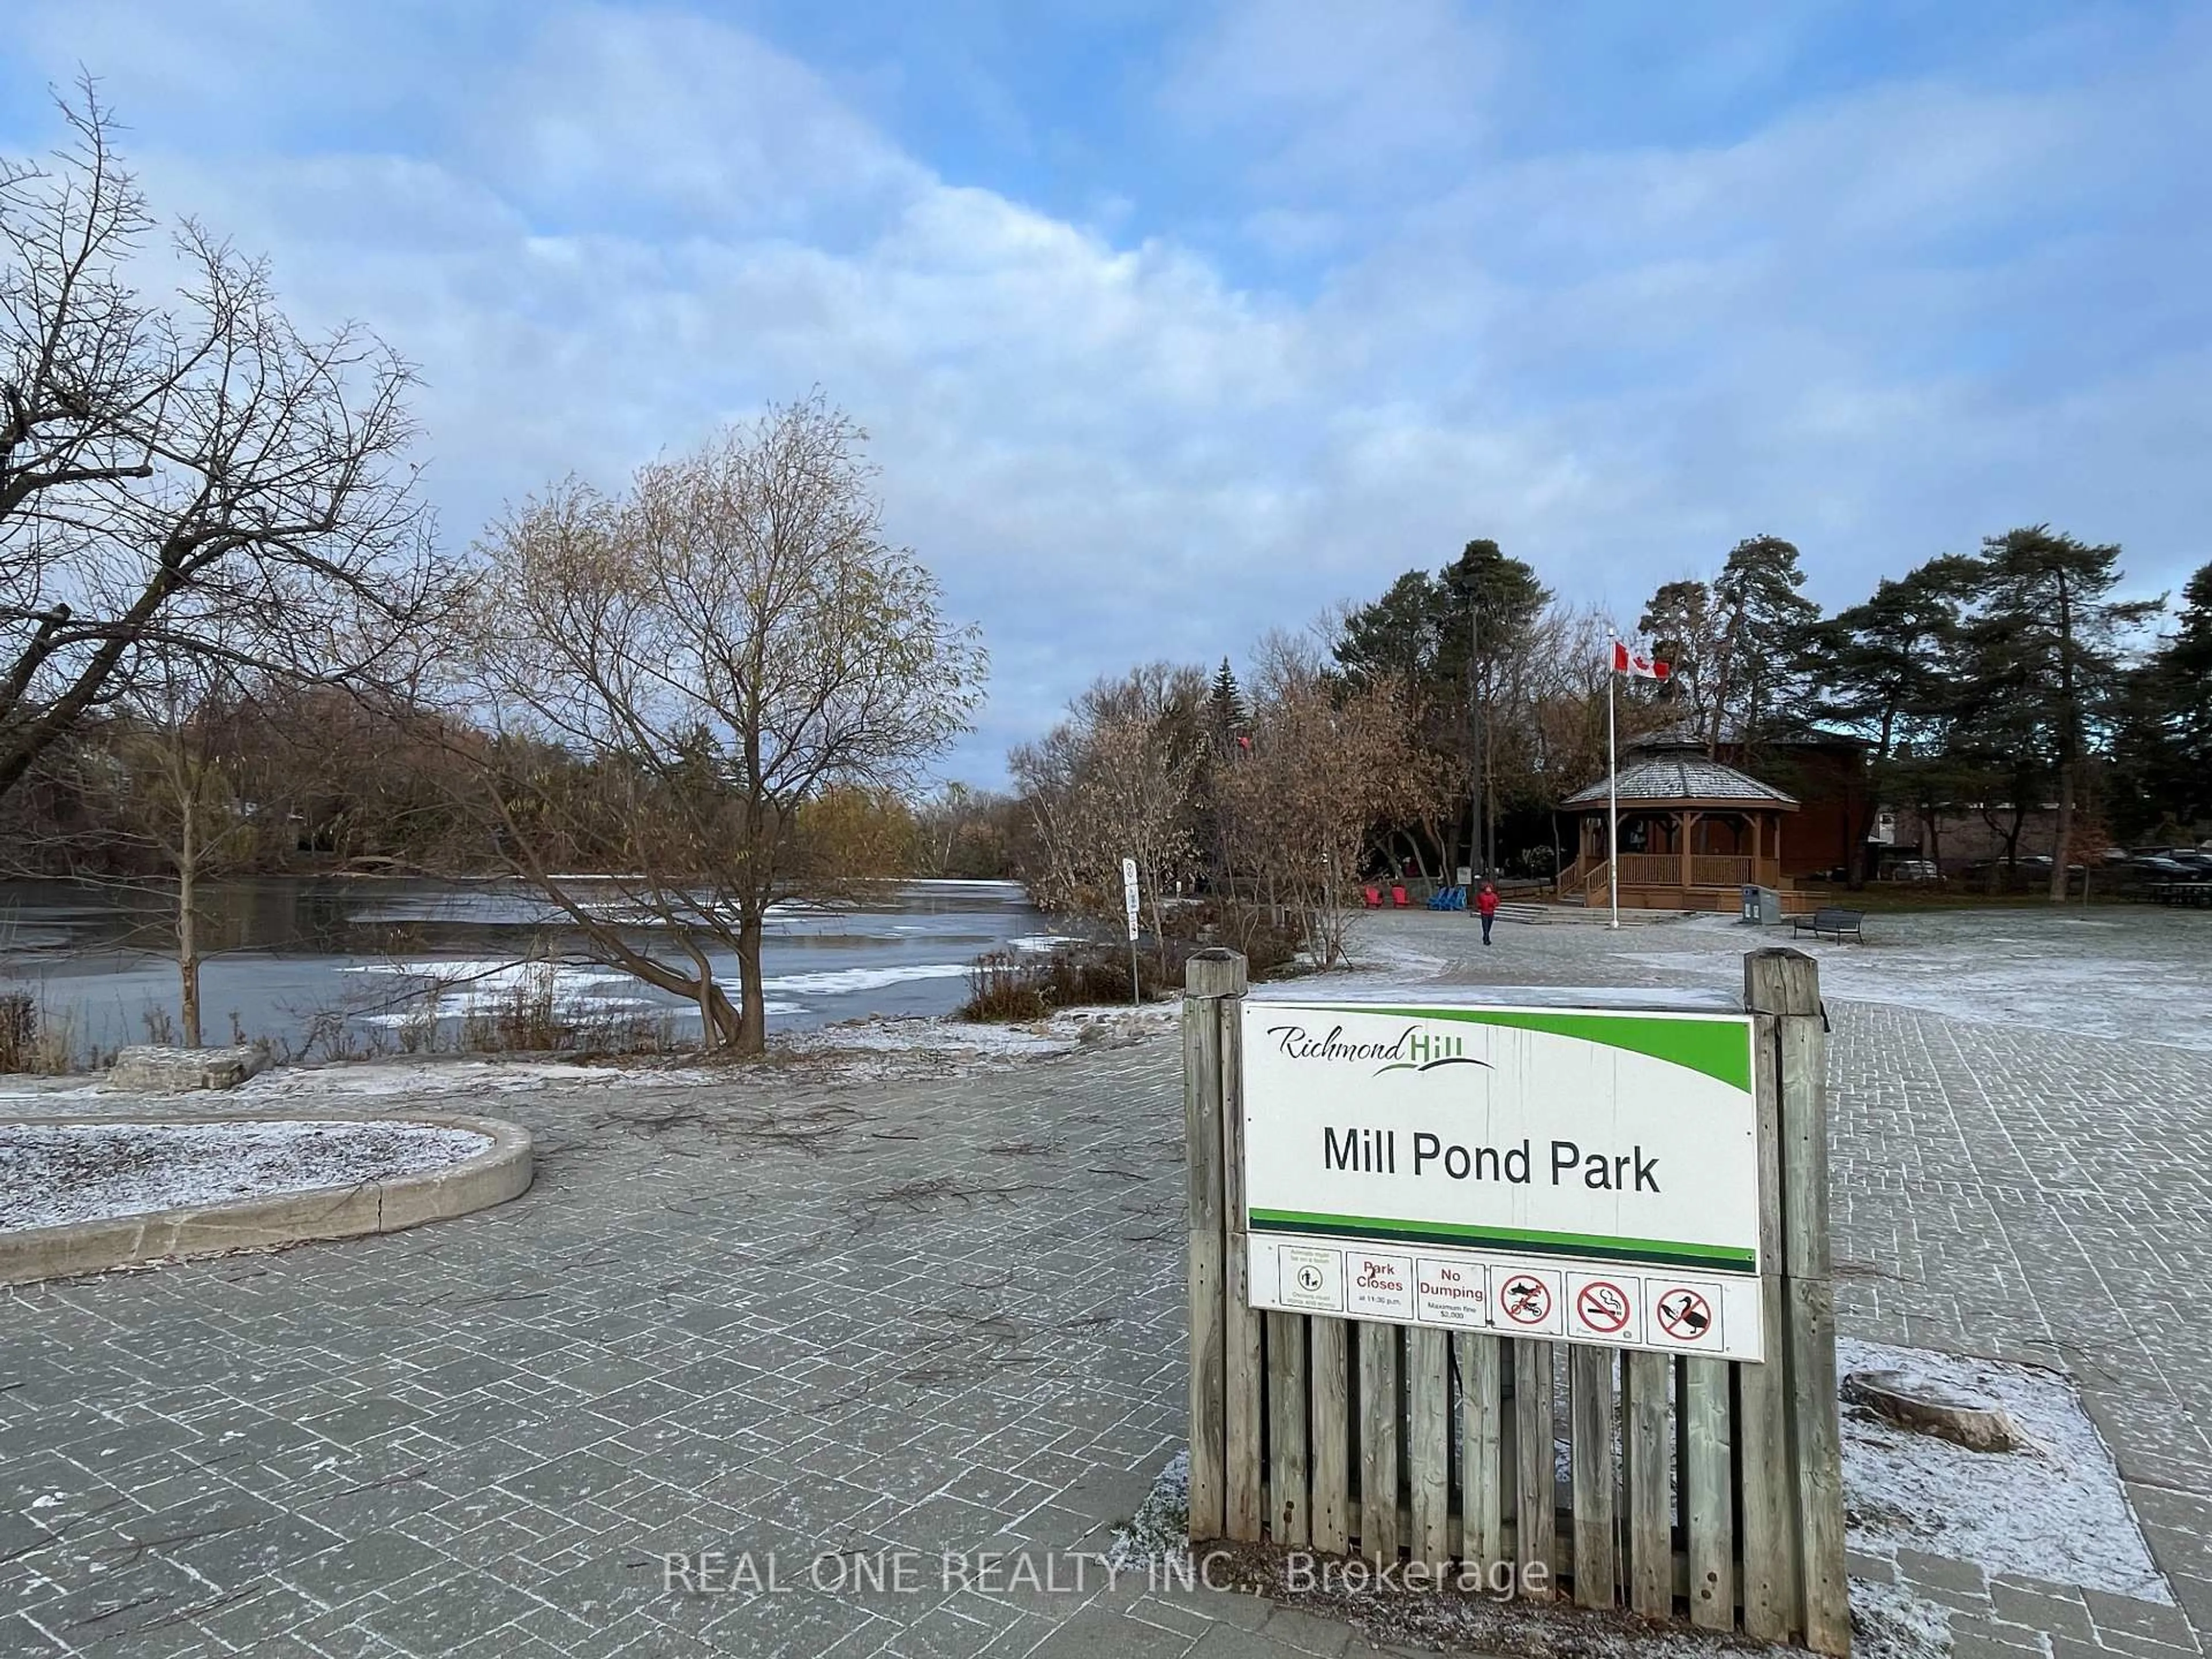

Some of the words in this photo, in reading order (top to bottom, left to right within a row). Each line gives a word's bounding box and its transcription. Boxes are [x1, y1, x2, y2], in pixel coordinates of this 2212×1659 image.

[1267, 1025, 1424, 1062] Richmond
[1411, 1034, 1462, 1062] Hill
[1324, 1127, 1395, 1174] Mill
[1413, 1132, 1531, 1184] Pond
[1551, 1140, 1661, 1193] Park
[1363, 1261, 1395, 1275] Park
[1441, 1268, 1461, 1282] No
[1357, 1275, 1403, 1291] Closes
[1420, 1282, 1483, 1302] Dumping
